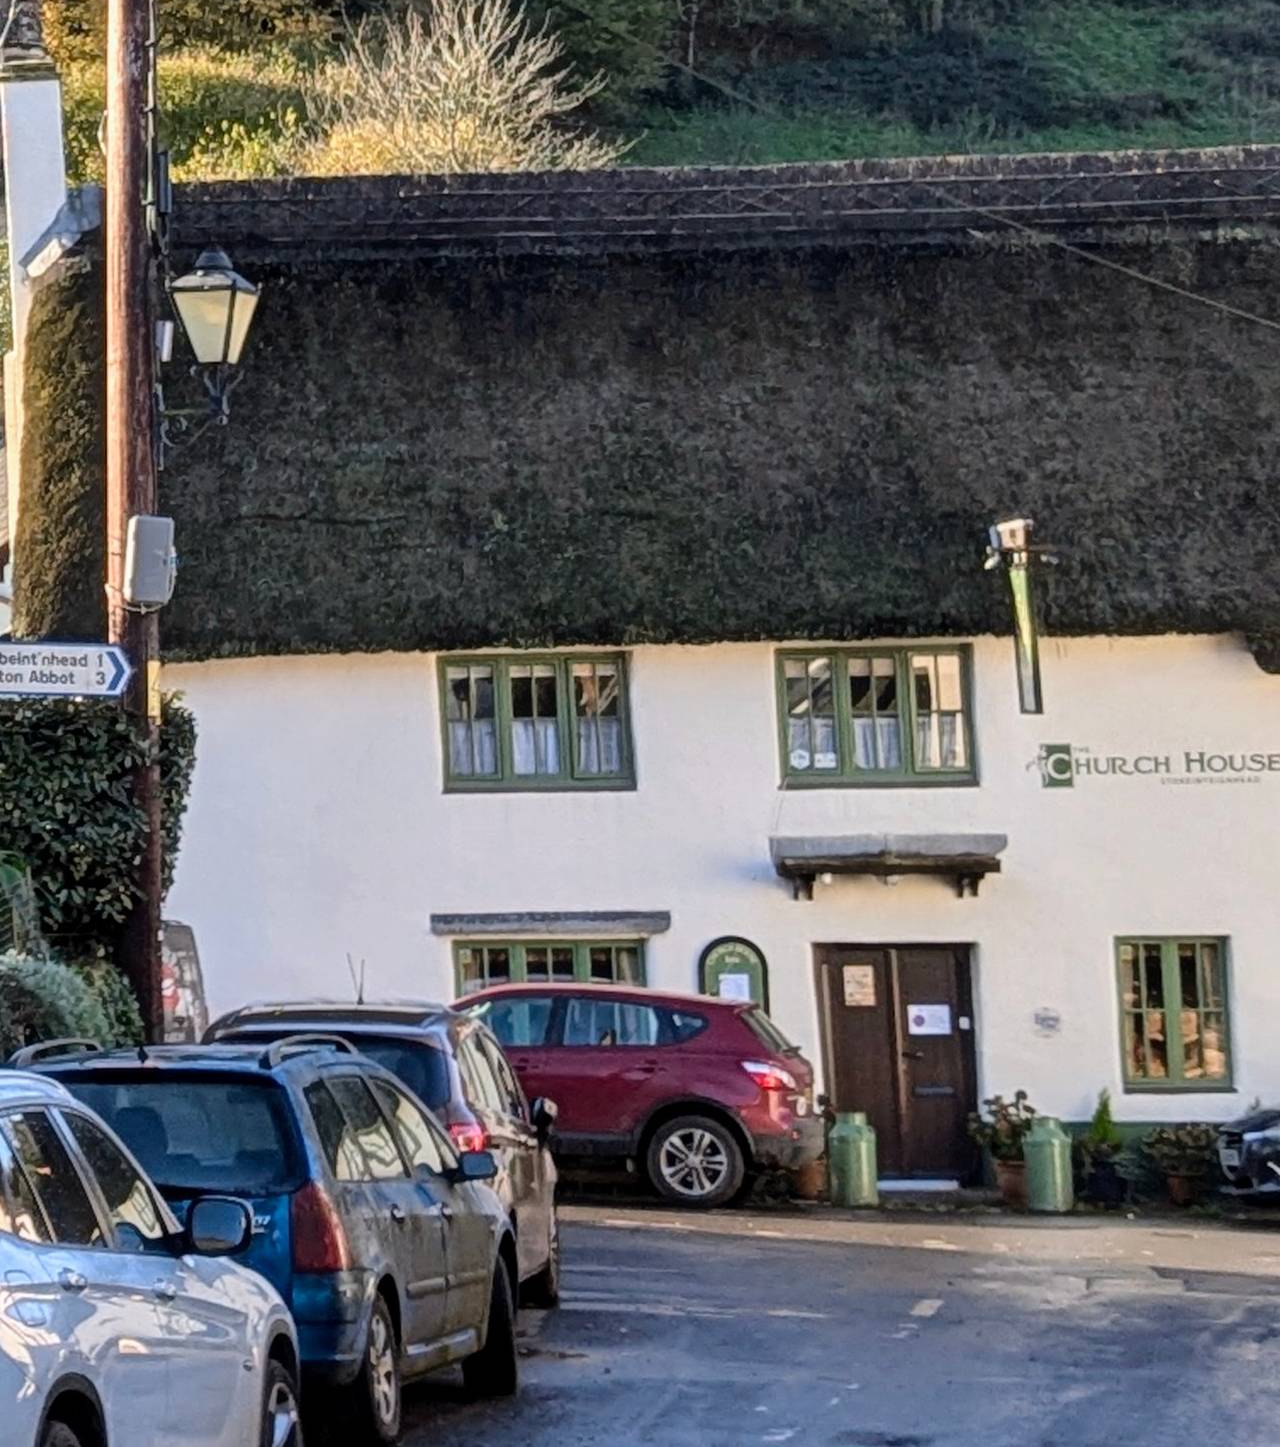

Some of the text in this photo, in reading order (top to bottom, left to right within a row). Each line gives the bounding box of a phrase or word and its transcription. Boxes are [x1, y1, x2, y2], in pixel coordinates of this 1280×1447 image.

[97, 654, 104, 667] 1
[29, 669, 75, 684] Abbot
[96, 672, 106, 685] 3
[1047, 751, 1280, 780] CHURCH HOUSE
